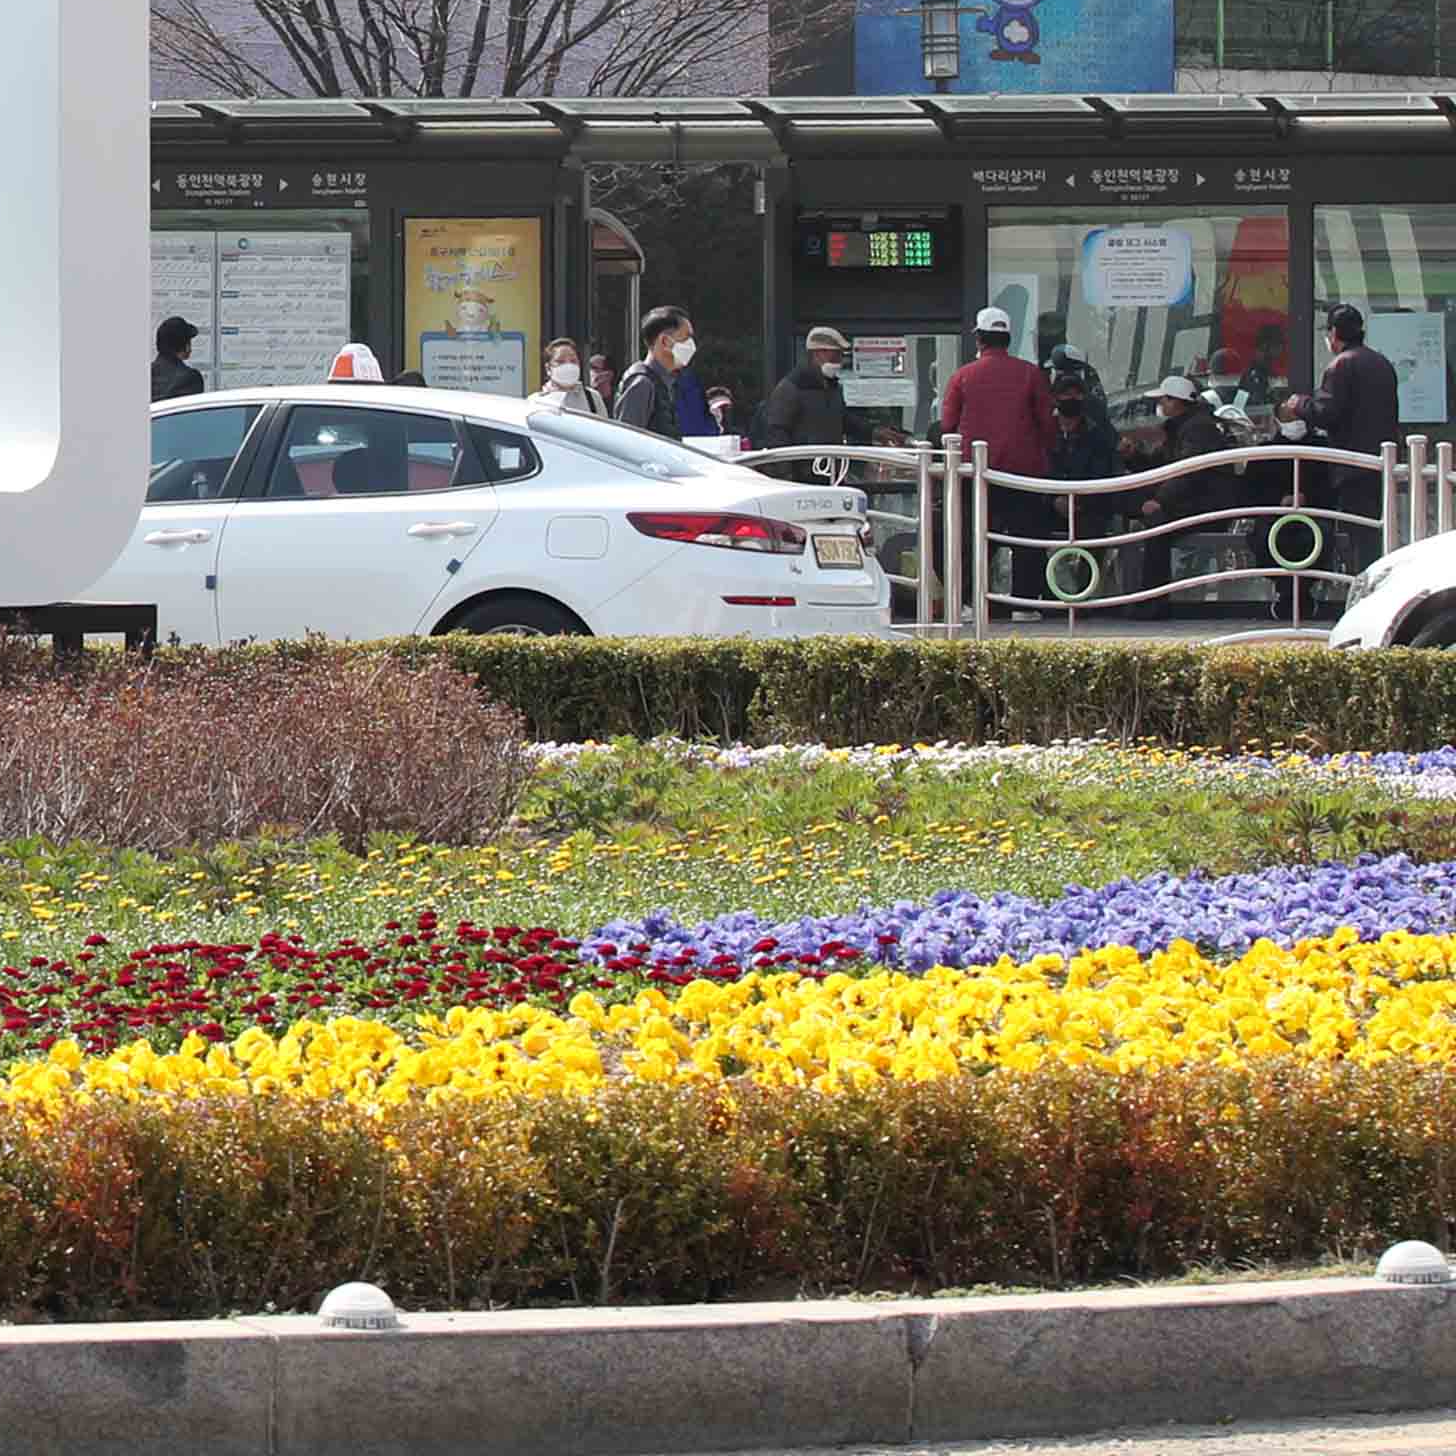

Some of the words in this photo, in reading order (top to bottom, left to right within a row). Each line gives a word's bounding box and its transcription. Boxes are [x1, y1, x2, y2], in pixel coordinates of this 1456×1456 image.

[175, 173, 263, 189] 동인천역북광장
[311, 173, 367, 187] 송현시장
[972, 169, 1046, 184] 배다리삼거리
[1090, 168, 1180, 184] 동인천역북광장
[1234, 168, 1291, 183] 송현시장
